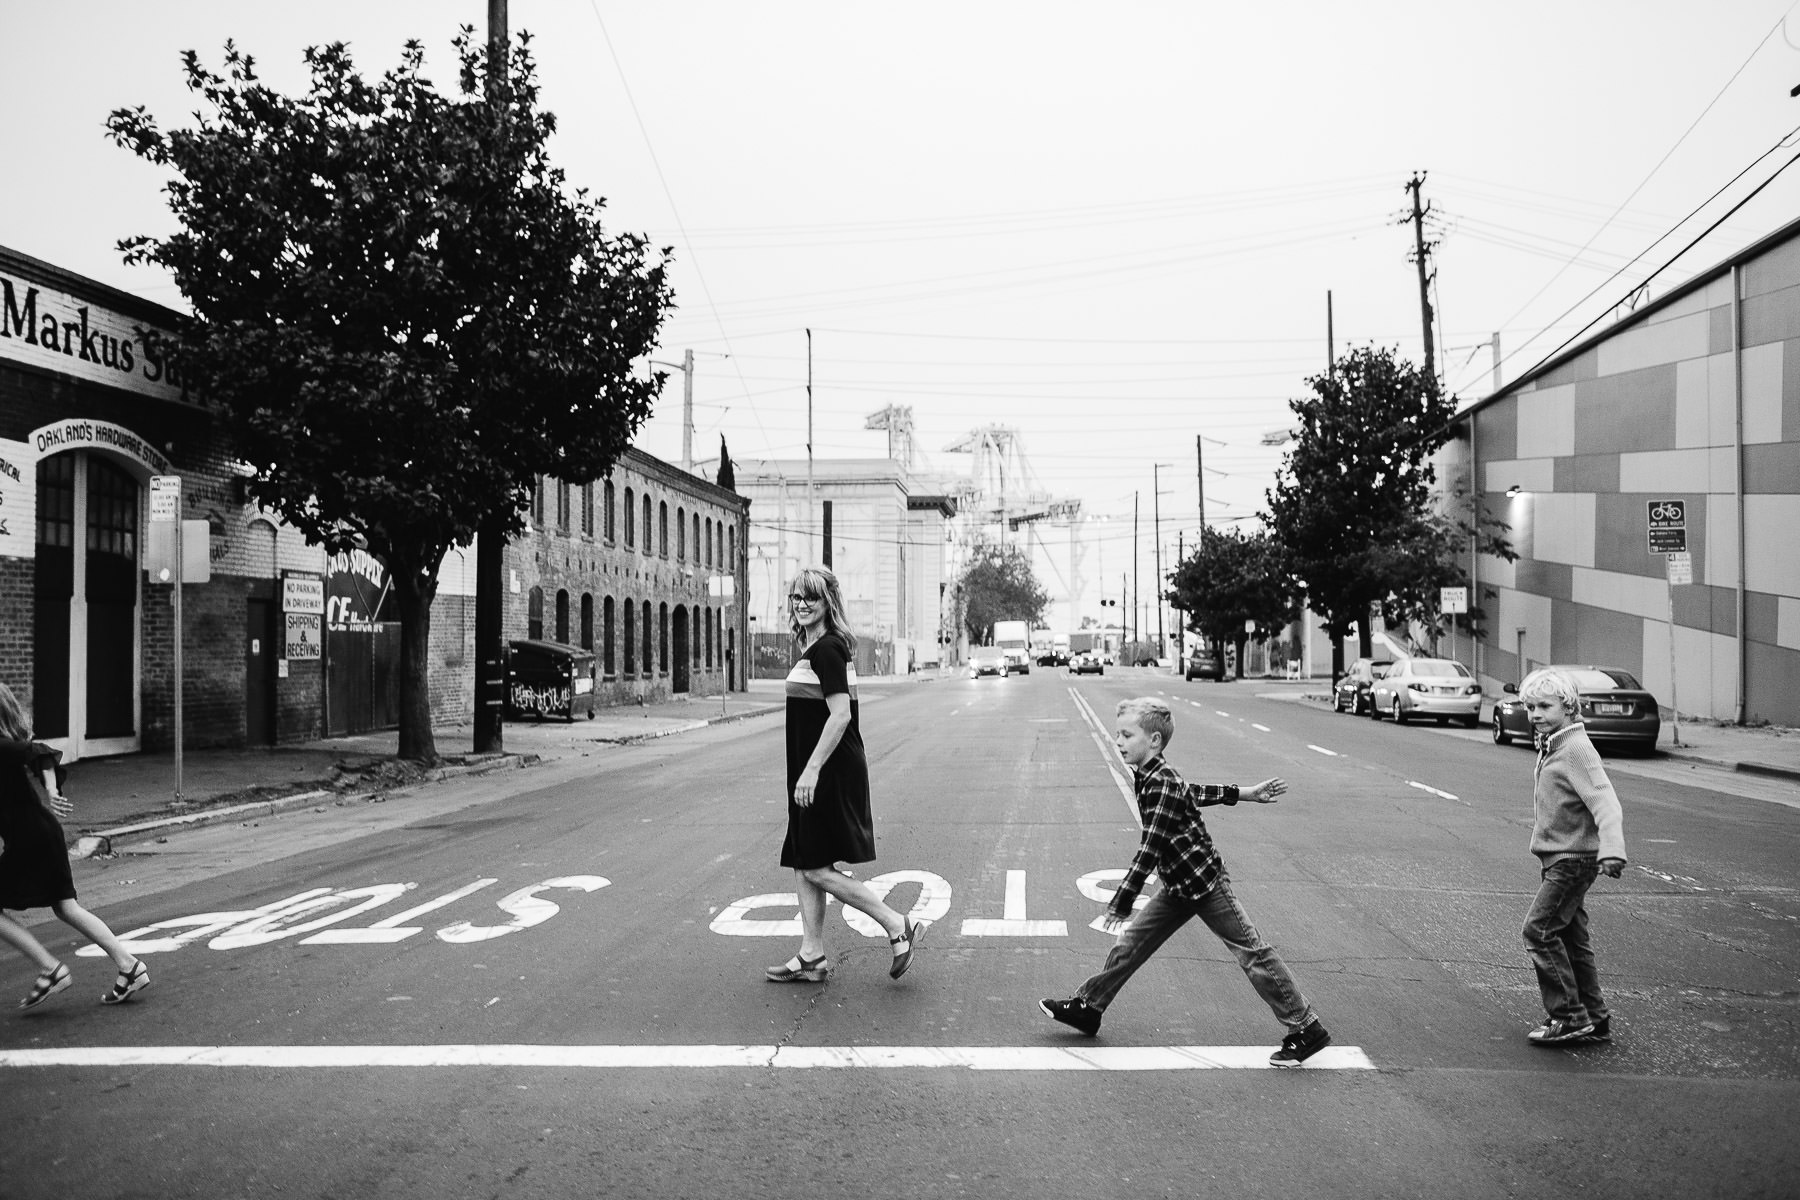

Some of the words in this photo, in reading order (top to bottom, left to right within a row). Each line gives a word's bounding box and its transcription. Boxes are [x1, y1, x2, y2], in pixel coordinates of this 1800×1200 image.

[0, 277, 136, 374] Markus
[37, 421, 93, 452] OAKLAND'S
[95, 425, 143, 456] HARDWARE
[142, 446, 168, 473] STORE
[287, 583, 295, 593] NO
[296, 583, 321, 595] PARKING
[286, 598, 291, 608] IN
[292, 599, 321, 609] DRIVEWAY
[287, 615, 319, 630] SHIPPING
[300, 630, 308, 642] &
[287, 643, 320, 657] RECEIVING
[709, 868, 1166, 937] STOP
